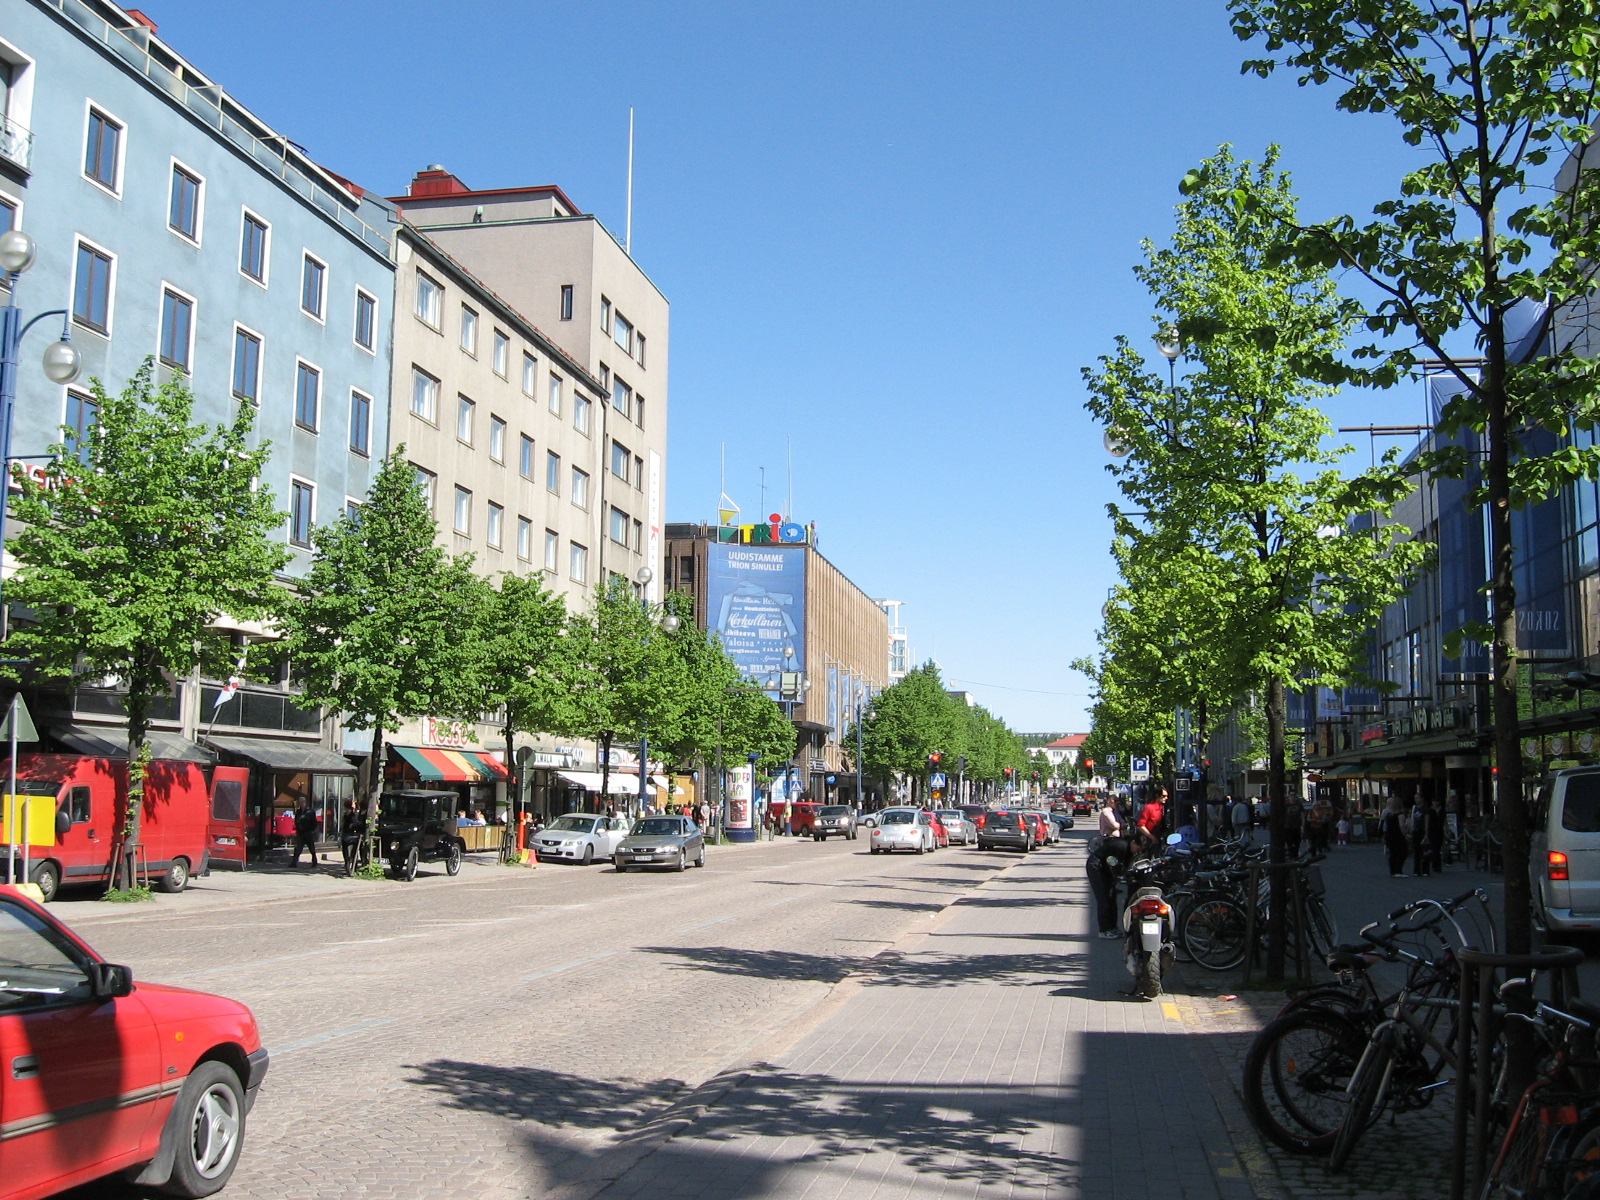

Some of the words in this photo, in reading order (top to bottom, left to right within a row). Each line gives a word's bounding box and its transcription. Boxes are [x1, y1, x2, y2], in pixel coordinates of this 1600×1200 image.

[728, 551, 784, 563] UUDISTAMME
[728, 560, 750, 570] TRION
[751, 563, 783, 571] SINULLE!
[1136, 760, 1144, 769] P
